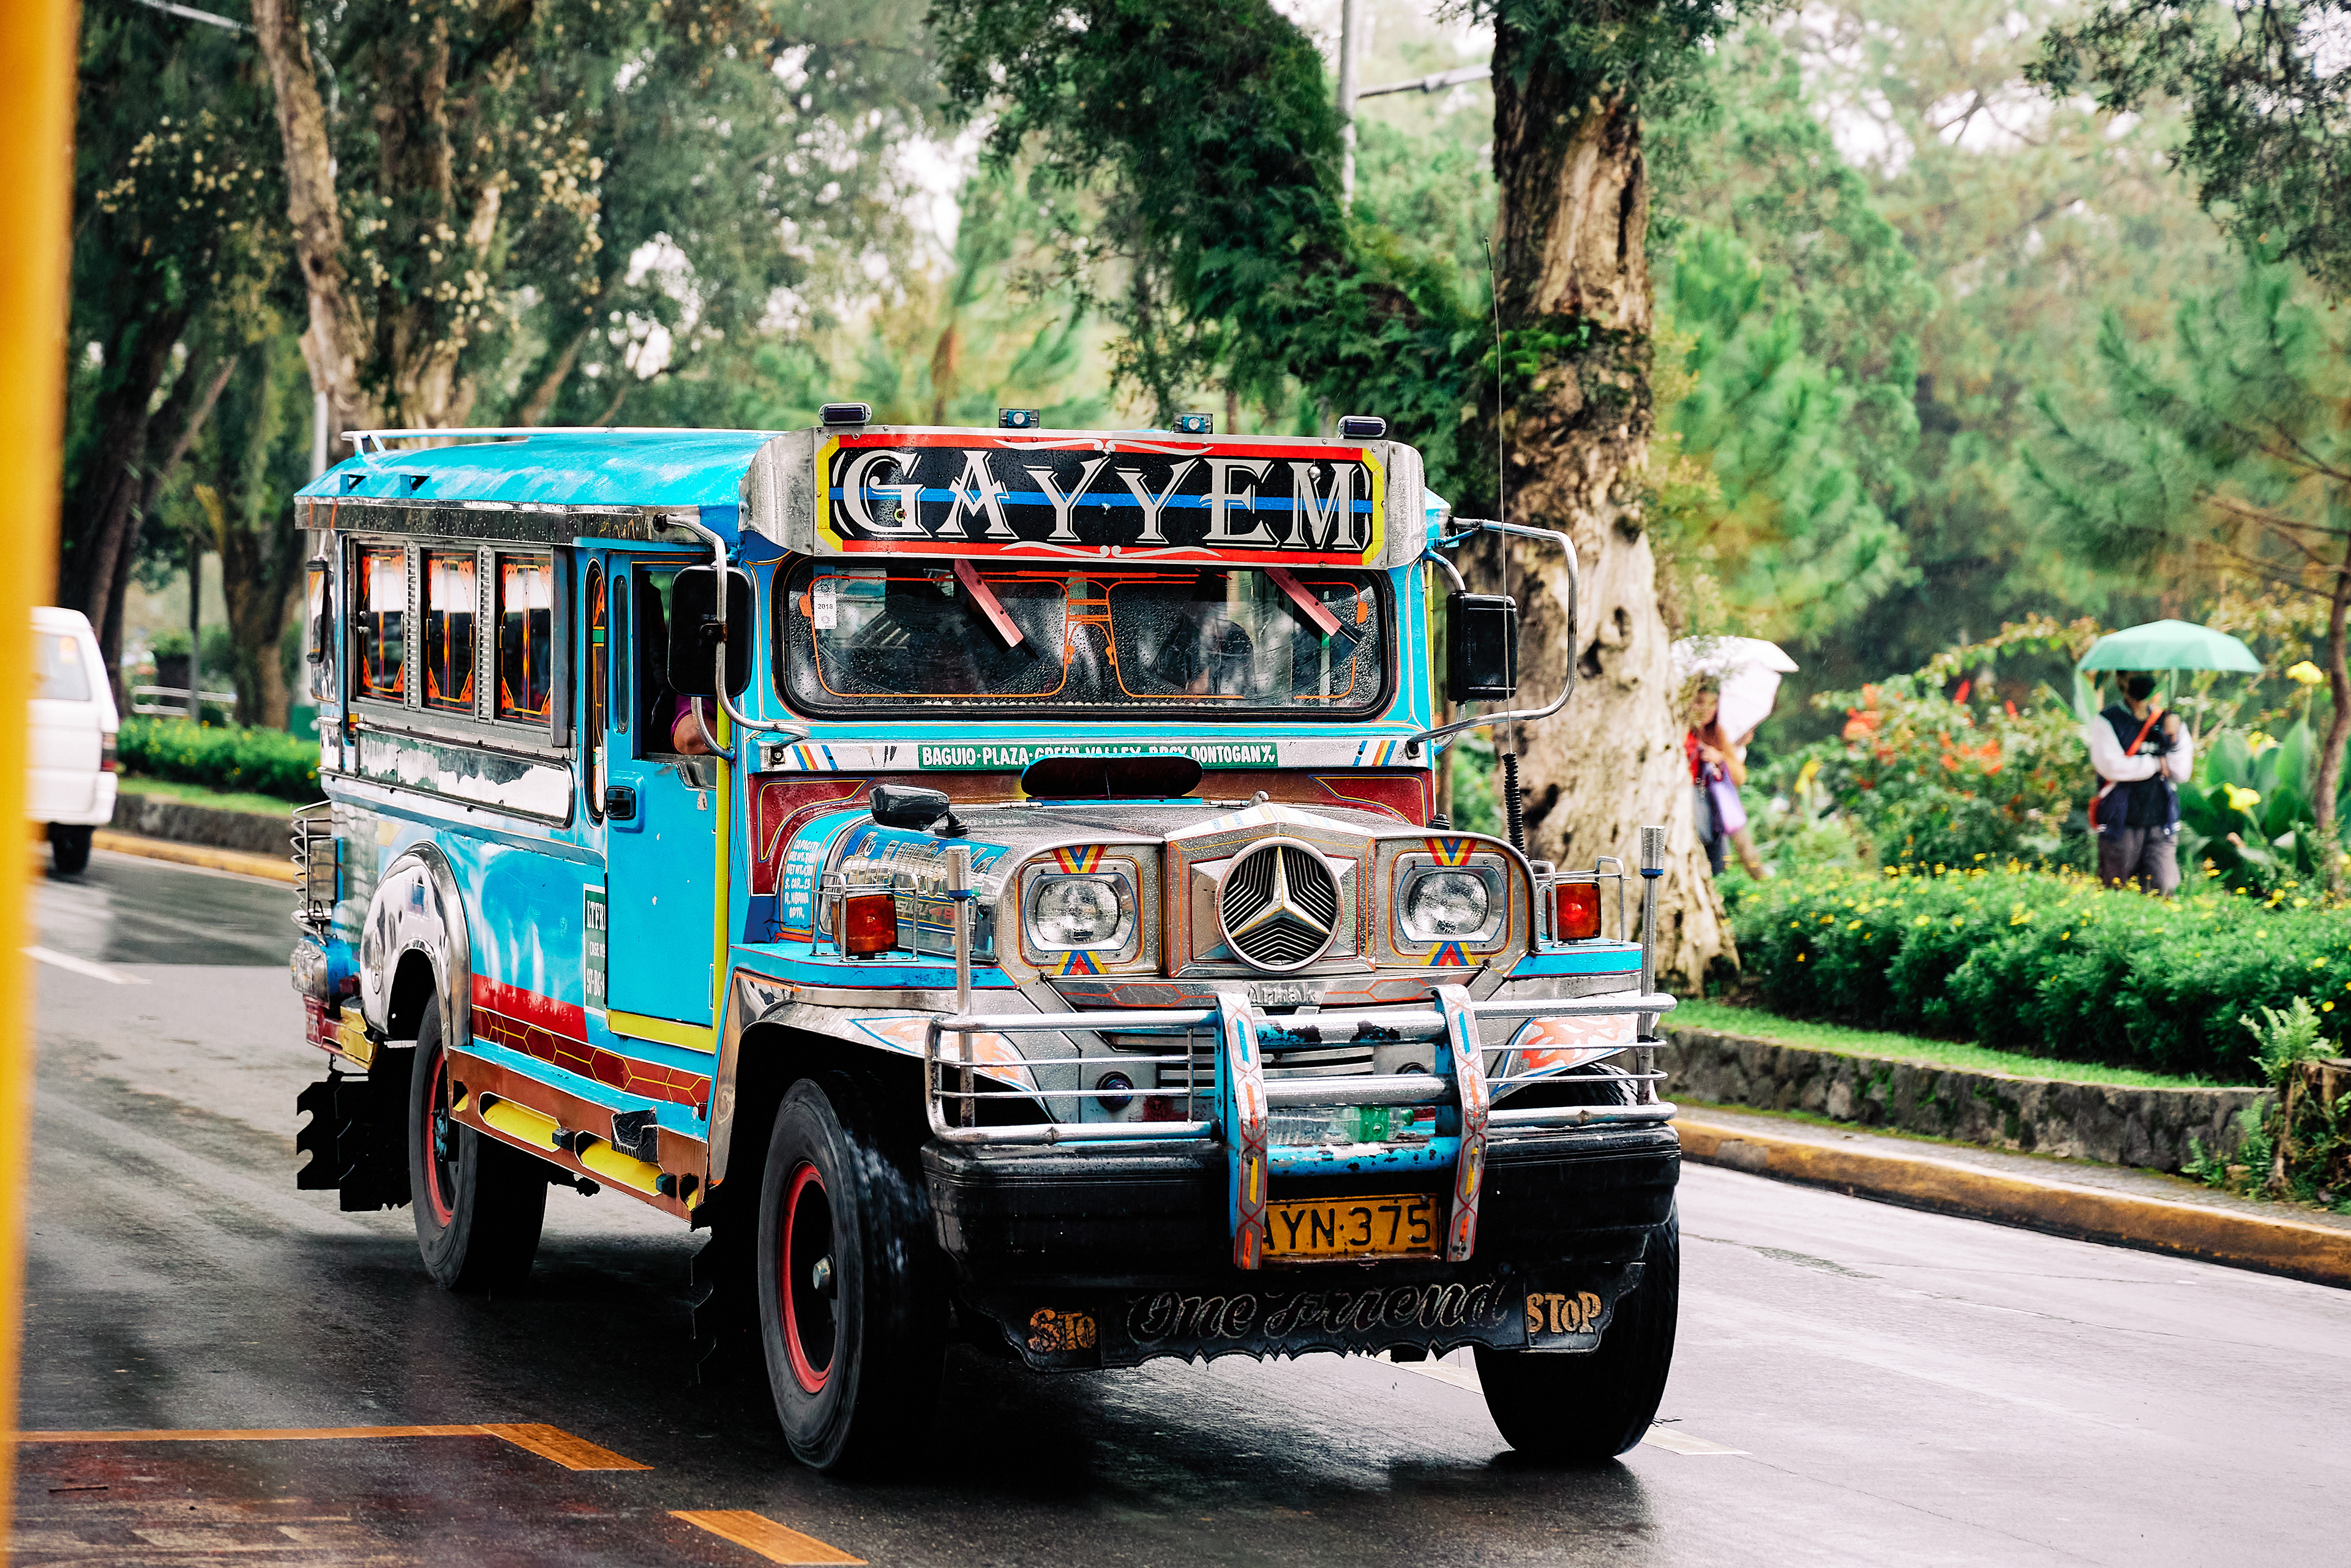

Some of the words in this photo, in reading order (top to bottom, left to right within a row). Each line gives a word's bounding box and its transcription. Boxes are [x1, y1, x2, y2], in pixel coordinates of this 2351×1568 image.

[842, 449, 1363, 549] GAYYEM
[793, 839, 821, 852] CAPACITY
[1028, 1308, 1097, 1352] STO
[1527, 1291, 1602, 1335] STOP
